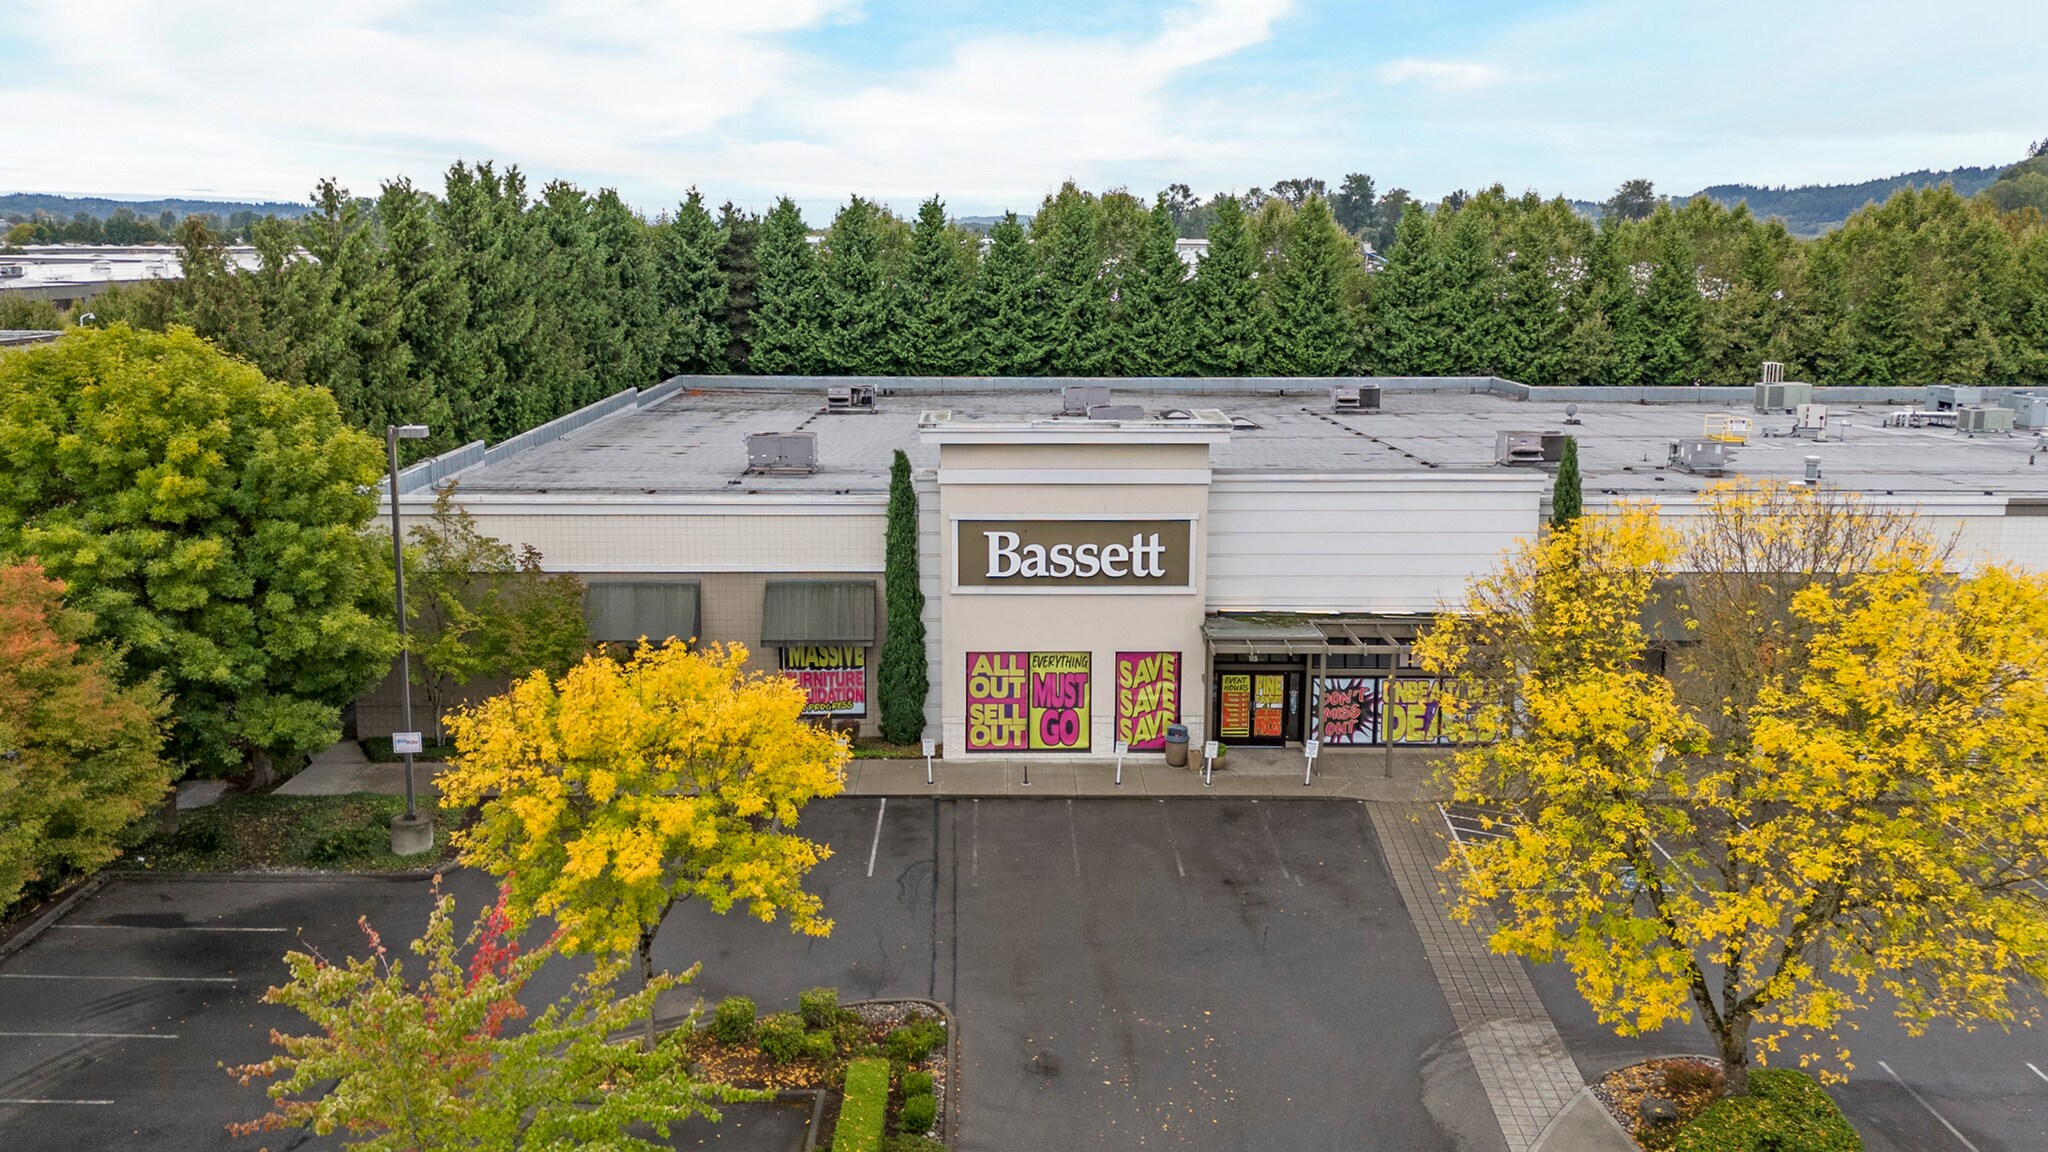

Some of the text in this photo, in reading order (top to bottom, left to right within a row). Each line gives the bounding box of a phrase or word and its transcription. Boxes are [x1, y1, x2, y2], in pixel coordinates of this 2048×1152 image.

[983, 531, 1166, 578] Bassett
[788, 646, 865, 667] MASSIVE
[971, 654, 1025, 676] ALL
[1032, 655, 1088, 668] EVERYTHING
[1120, 652, 1175, 689] SAVE
[1224, 676, 1248, 684] EVENT
[804, 687, 864, 703] UIDATION
[969, 676, 1026, 699] OUT
[1032, 672, 1089, 709] MUST
[1223, 684, 1249, 692] HOURS
[807, 701, 854, 713] PROGRESS
[1120, 681, 1176, 718] SAVE
[969, 703, 1027, 725] SELL
[1323, 704, 1361, 722] MISS
[1381, 703, 1498, 742] DEA
[969, 724, 1026, 747] OUT
[1040, 708, 1080, 746] GO
[1120, 710, 1176, 746] SAVE
[1325, 720, 1359, 736] OUT
